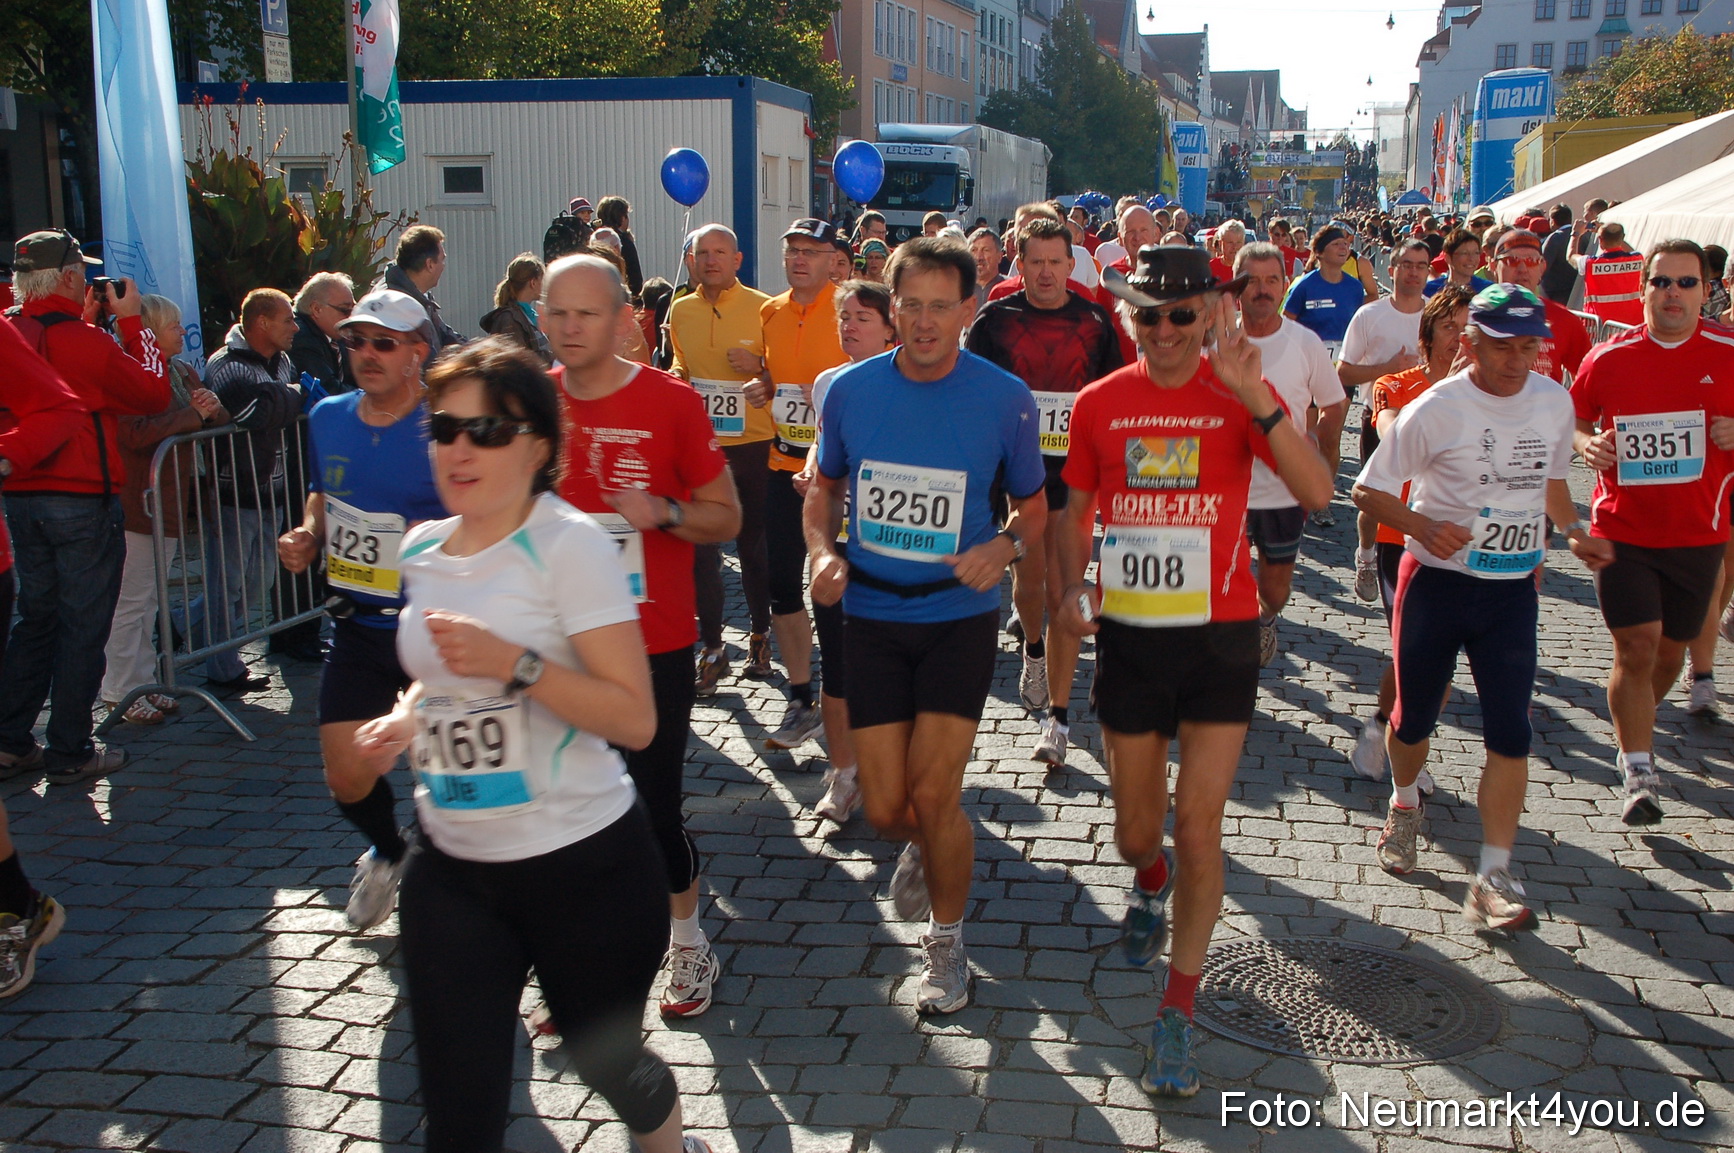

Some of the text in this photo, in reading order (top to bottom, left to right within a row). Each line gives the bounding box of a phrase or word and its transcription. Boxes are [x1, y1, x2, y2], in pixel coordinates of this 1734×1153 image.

[1491, 81, 1545, 110] maxi
[1178, 130, 1200, 148] axi
[1183, 155, 1197, 166] dsl
[1594, 262, 1642, 273] NOTARZT
[702, 394, 738, 416] 128
[786, 400, 816, 424] 27
[711, 417, 723, 428] alf
[1038, 408, 1072, 432] 13
[1109, 415, 1189, 430] SALOMON
[789, 426, 816, 439] Geor
[1039, 434, 1069, 448] risto
[1625, 430, 1692, 460] 3351
[1643, 461, 1678, 476] Gerd
[867, 486, 950, 530] 3250
[1112, 491, 1218, 515] GORE-TEX
[330, 525, 380, 566] 423
[875, 524, 936, 551] Jürgen
[1479, 522, 1539, 552] 2061
[328, 557, 375, 584] Bernd
[1122, 552, 1185, 590] 908
[1477, 553, 1536, 569] Reinhold
